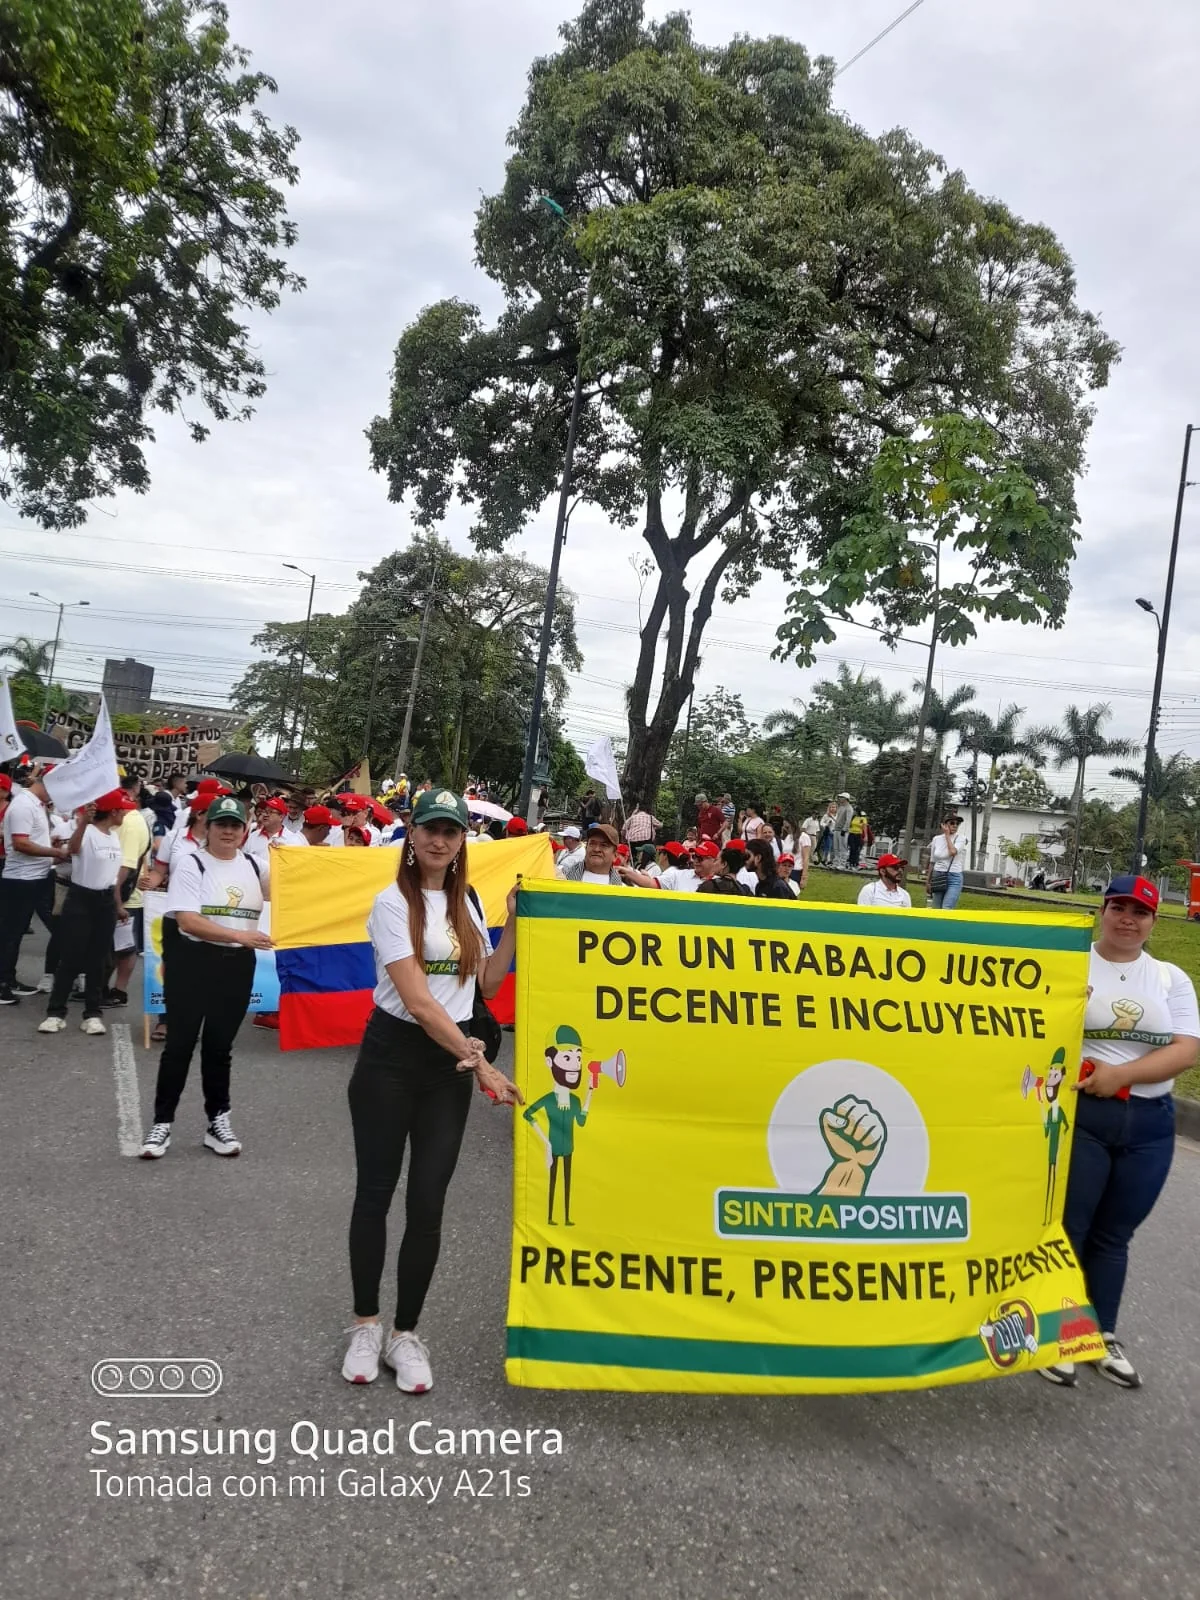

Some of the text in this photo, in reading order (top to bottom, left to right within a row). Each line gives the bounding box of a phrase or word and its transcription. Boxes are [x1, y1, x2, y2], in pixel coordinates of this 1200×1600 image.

[114, 731, 147, 746] UNA
[151, 727, 222, 748] MULTITUD
[578, 930, 1051, 995] POR UN TRABAJO JUSTO,
[597, 985, 1046, 1039] DECENTE E INCLUYENTE
[724, 1200, 964, 1230] SINTRAPOSITIVA
[520, 1245, 736, 1303] PRESENTE,
[753, 1259, 957, 1304] PRESENTE,
